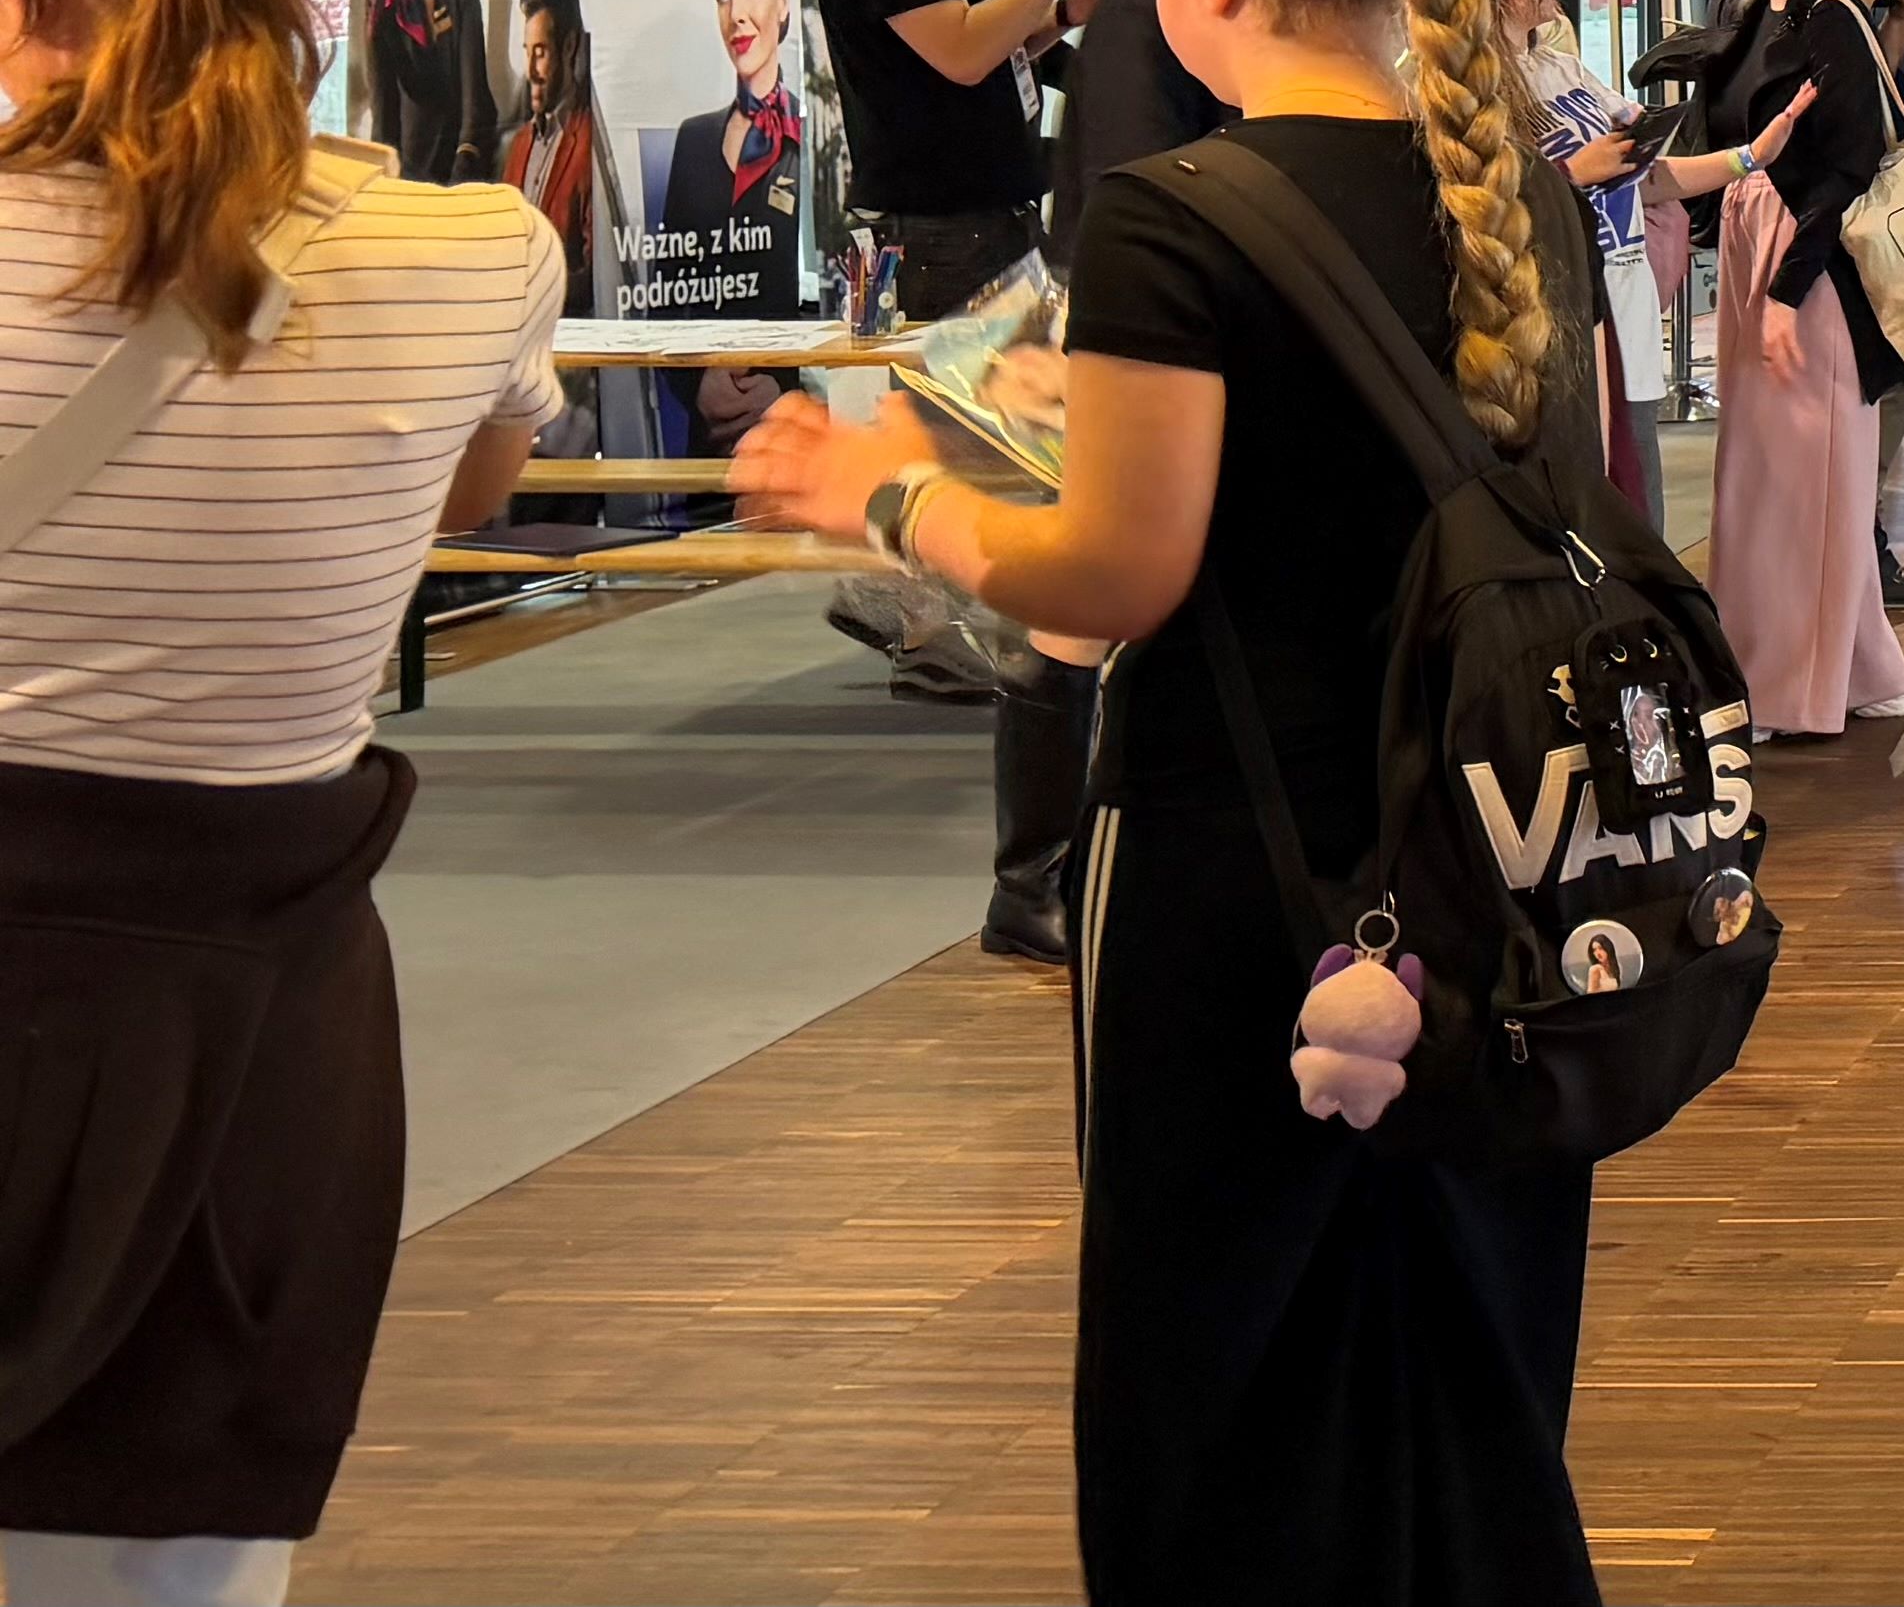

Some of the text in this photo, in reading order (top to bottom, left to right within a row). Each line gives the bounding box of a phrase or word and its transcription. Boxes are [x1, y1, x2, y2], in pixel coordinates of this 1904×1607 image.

[613, 216, 772, 262] Ważne, z kim
[616, 265, 760, 321] podróżujesz
